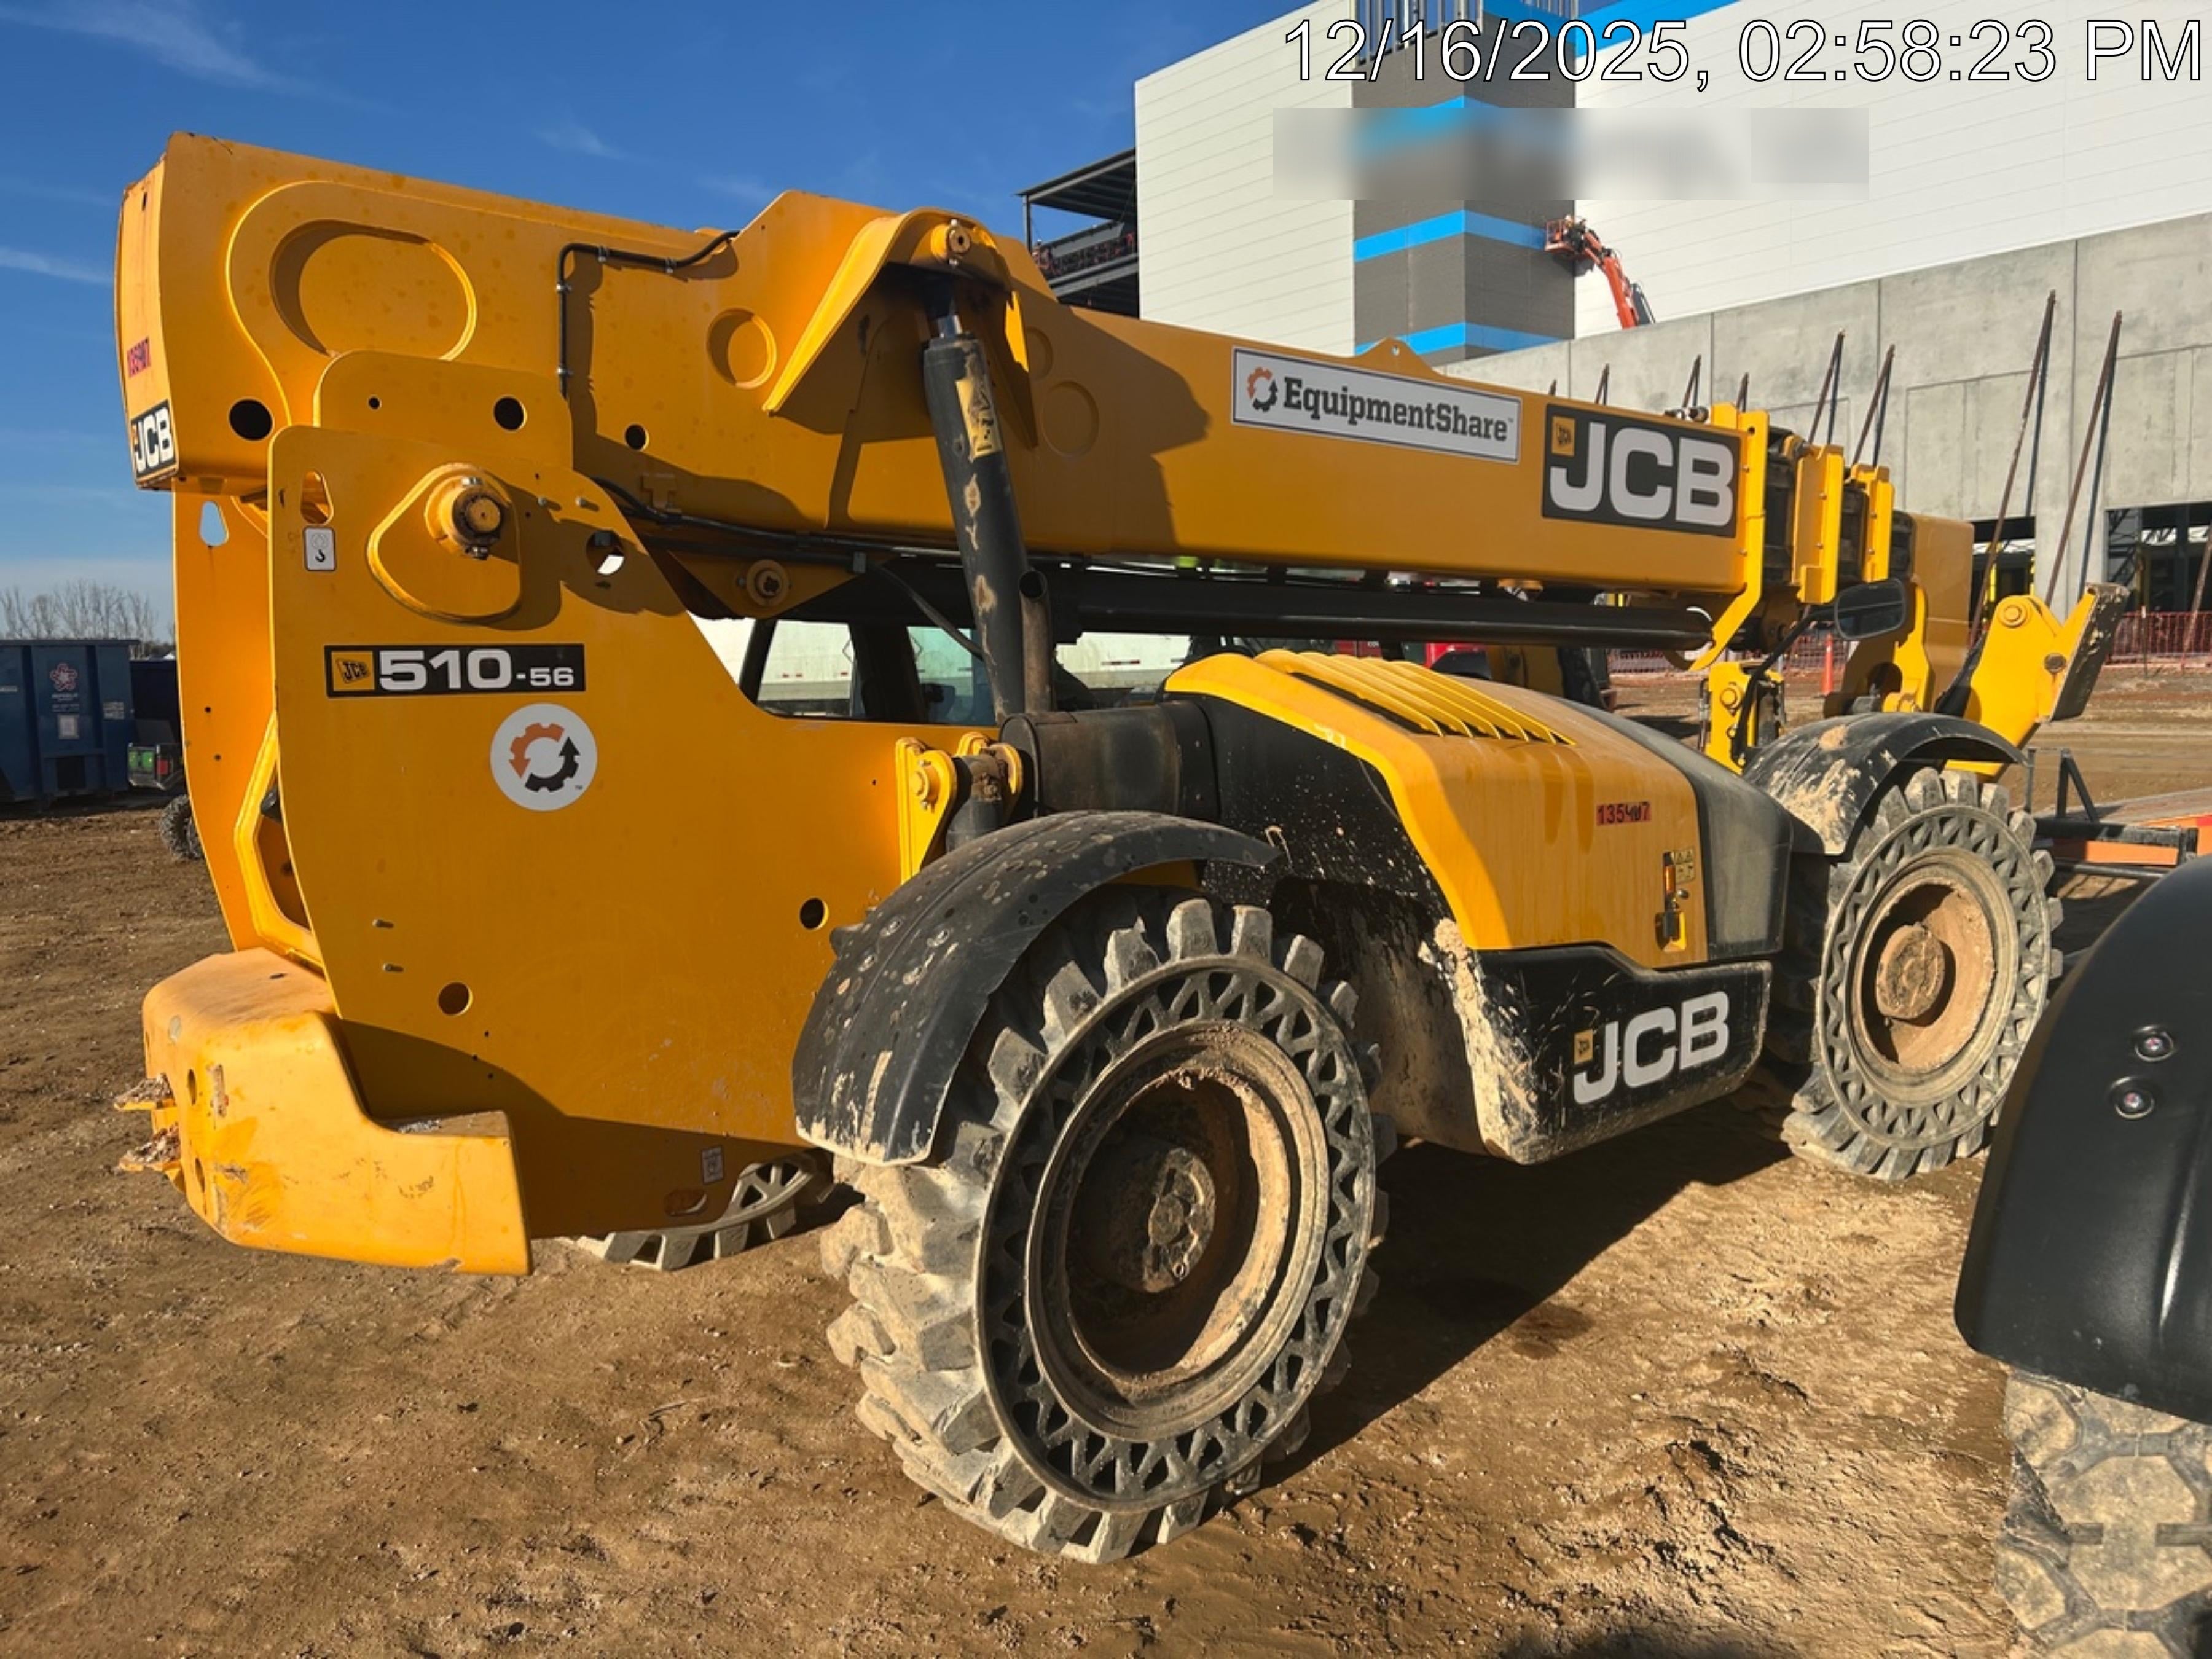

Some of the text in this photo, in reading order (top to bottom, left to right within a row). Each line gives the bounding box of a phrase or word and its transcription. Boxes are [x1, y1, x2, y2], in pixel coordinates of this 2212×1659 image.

[136, 407, 175, 473] JCB
[1283, 376, 1508, 441] EquipmentShare
[1550, 422, 1734, 527] JCB
[1574, 991, 1730, 1104] JCB
